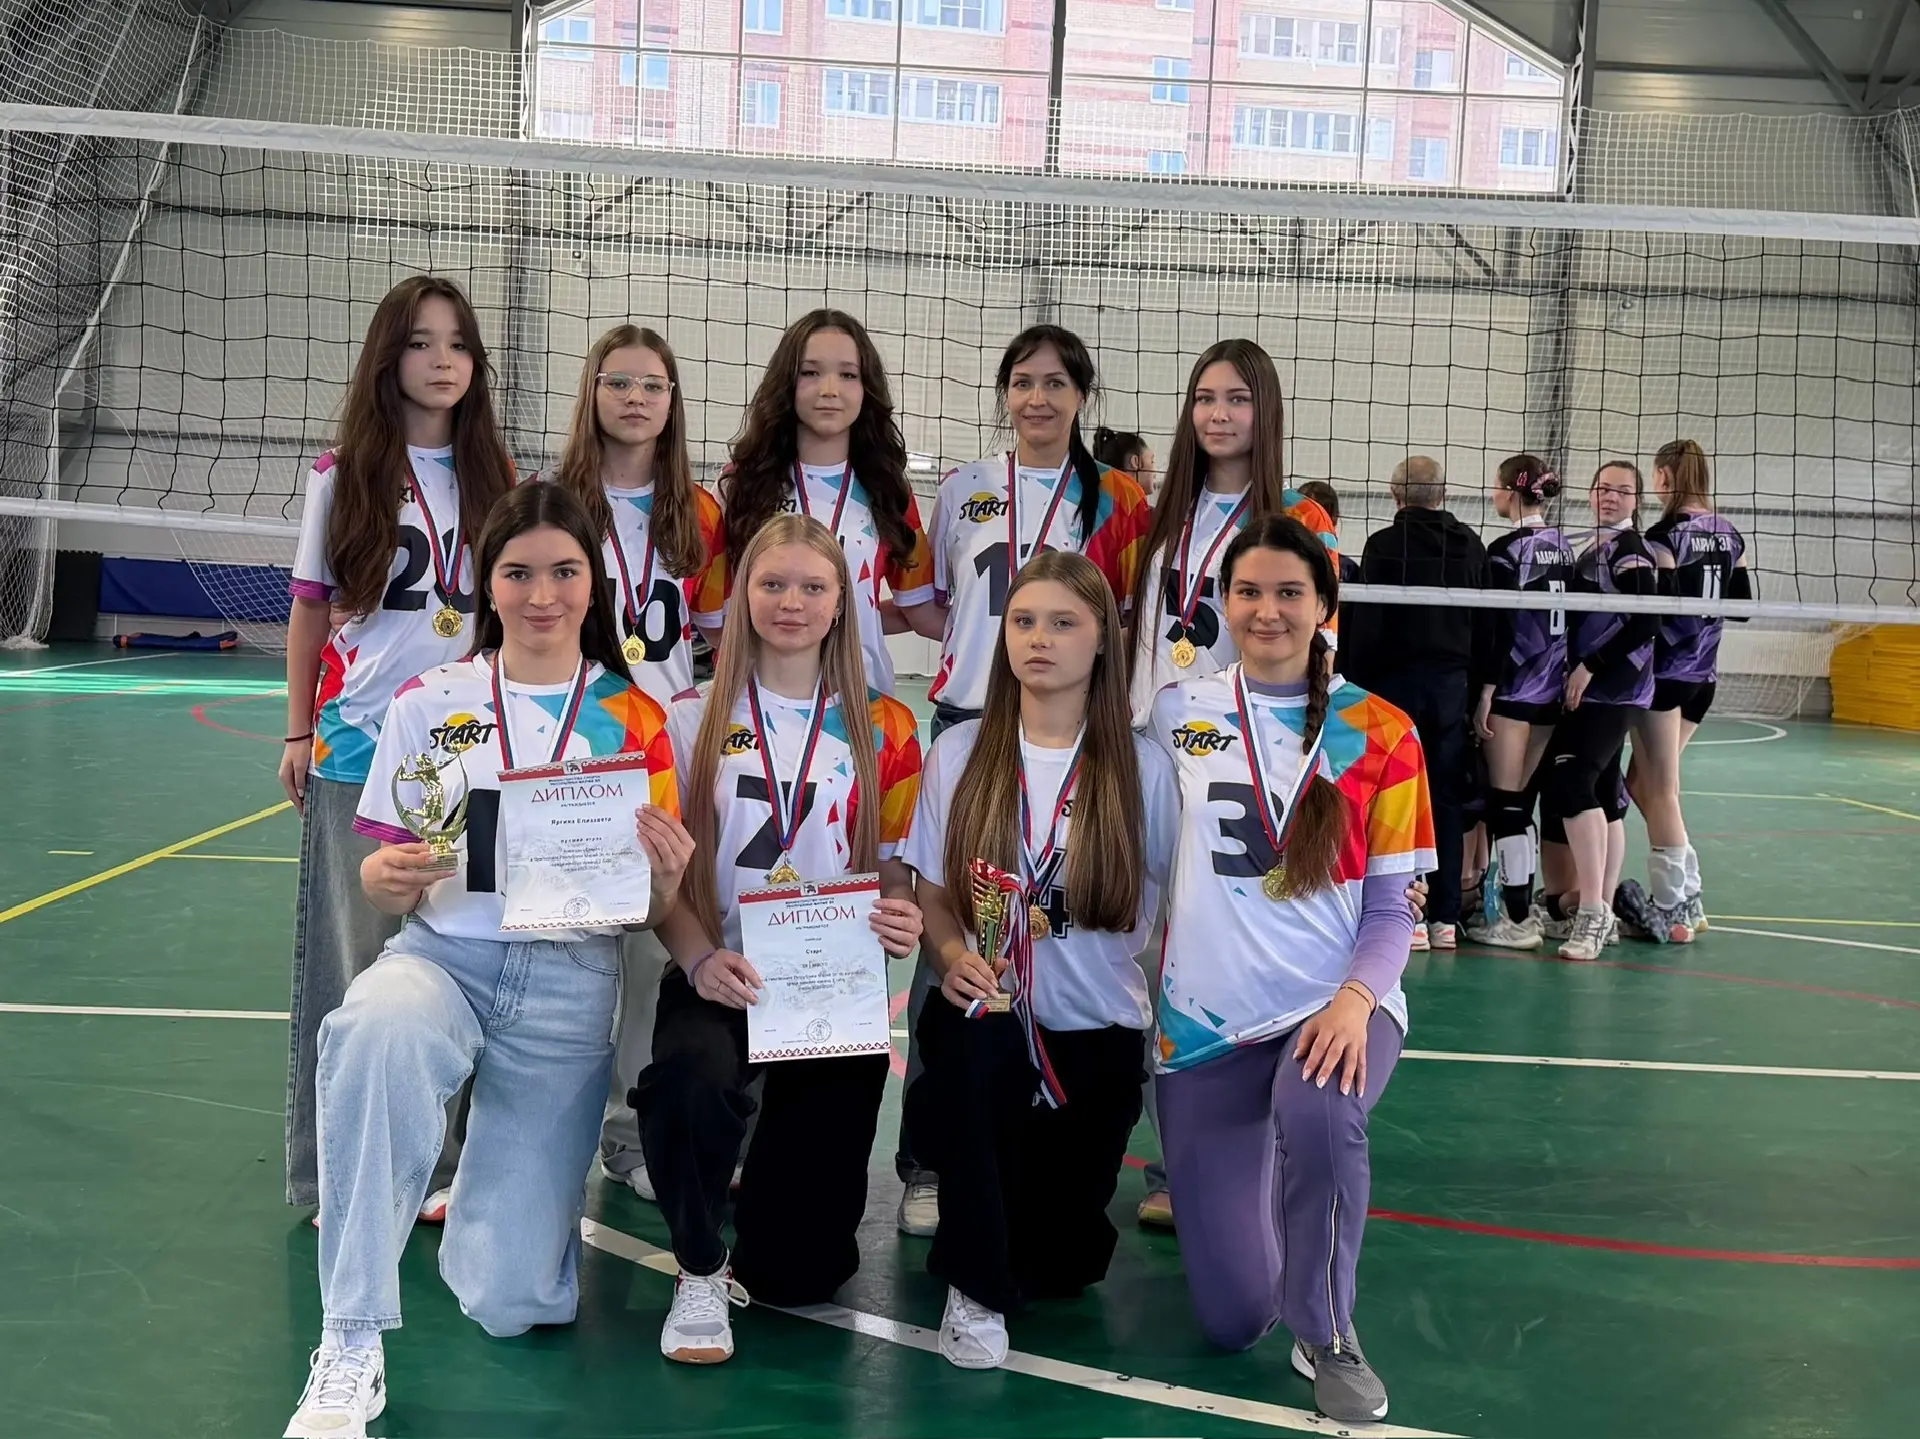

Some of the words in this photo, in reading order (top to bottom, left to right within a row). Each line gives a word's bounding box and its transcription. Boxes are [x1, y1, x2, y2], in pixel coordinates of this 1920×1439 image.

[959, 497, 1009, 520] START
[430, 720, 498, 749] START
[1172, 724, 1238, 751] START
[531, 783, 624, 803] ДИПЛОМ
[735, 774, 817, 870] 7
[1207, 782, 1285, 877] 3
[768, 905, 856, 926] ДИПЛОМ
